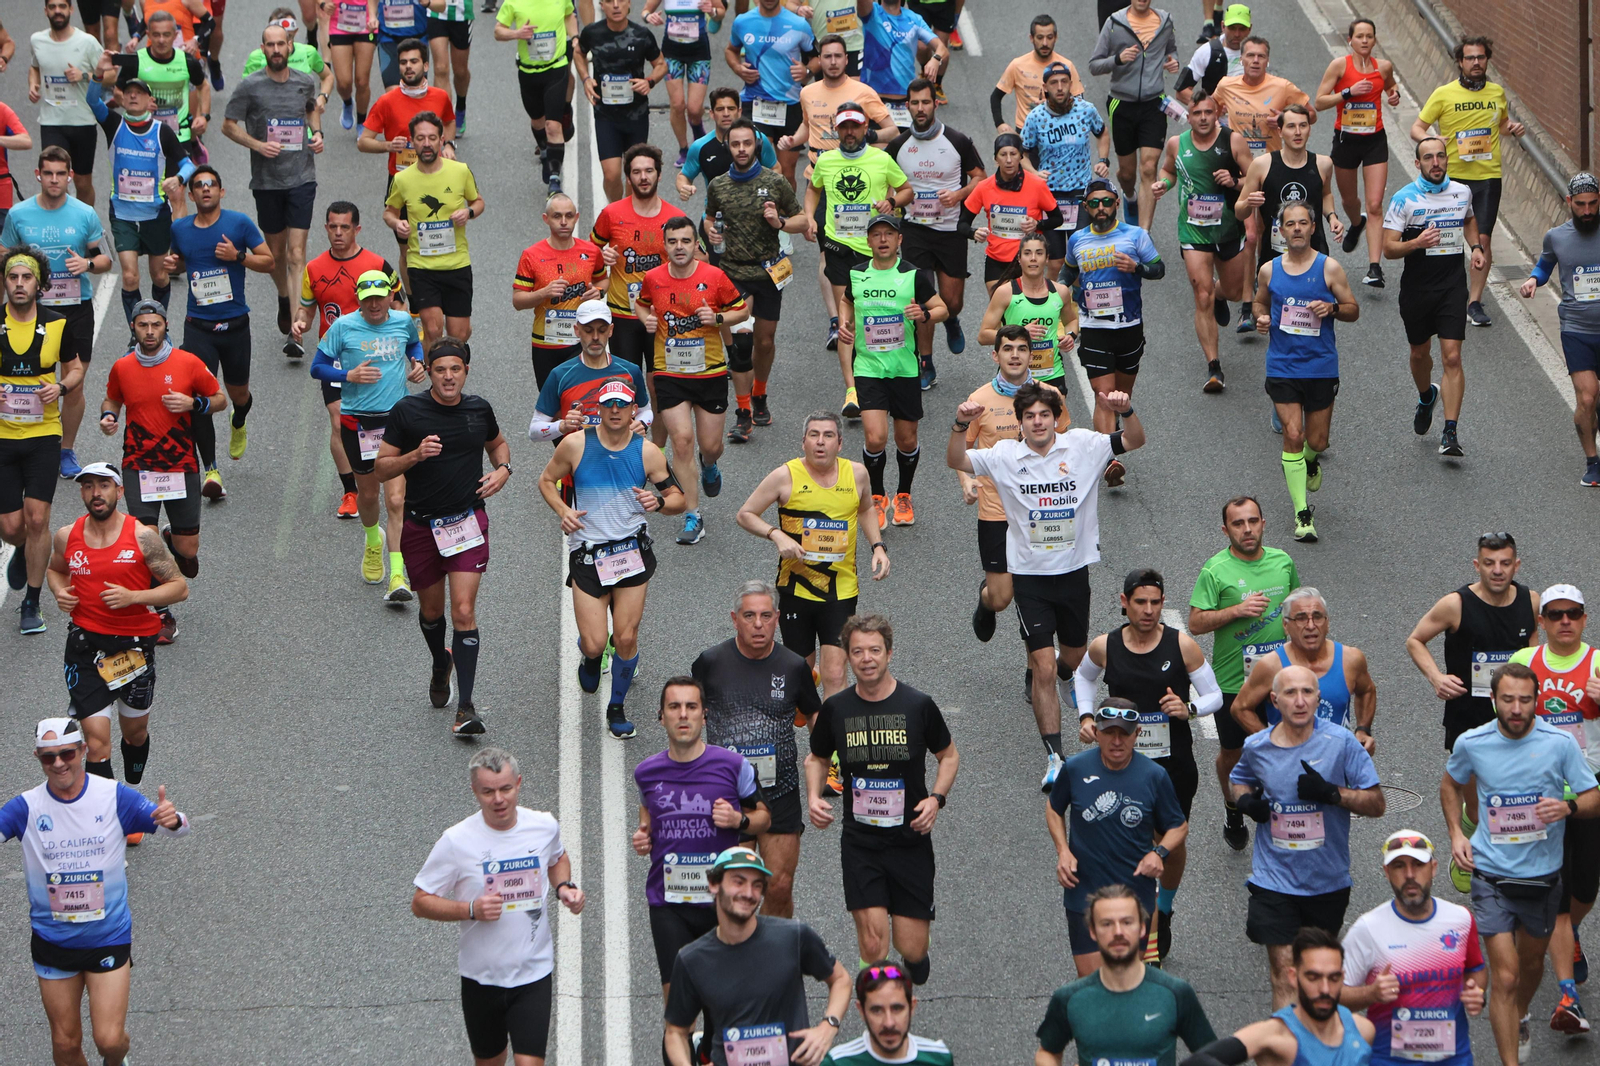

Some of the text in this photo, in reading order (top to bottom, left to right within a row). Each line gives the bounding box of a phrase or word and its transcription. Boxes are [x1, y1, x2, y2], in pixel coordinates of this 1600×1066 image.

[836, 8, 855, 17] ZURICH
[758, 35, 792, 44] ZURICH
[1047, 122, 1077, 145] COMO
[919, 160, 935, 169] edp
[130, 169, 151, 177] ZURICH
[428, 221, 449, 230] ZURICH
[1438, 220, 1460, 228] ZURICH
[1080, 244, 1115, 261] TEAM
[1095, 280, 1117, 288] ZURICH
[863, 289, 897, 299] sano
[876, 316, 899, 324] ZURICH
[606, 383, 623, 392] OTSO
[1020, 480, 1077, 495] SIEMENS
[1038, 495, 1079, 507] mobile
[1044, 510, 1070, 519] ZURICH
[819, 521, 845, 529] ZURICH
[770, 689, 785, 699] OTSO
[844, 713, 907, 731] RUN UTREG
[1547, 715, 1578, 724] ZURICH
[846, 729, 907, 748] RUN UTREG
[740, 747, 770, 756] ZURICH
[846, 746, 911, 763] RUN UTREG
[868, 780, 899, 789] ZURICH
[868, 796, 888, 805] 7435
[1504, 795, 1537, 805] ZURICH
[1285, 804, 1317, 813] ZURICH
[1505, 812, 1526, 822] 7495
[661, 817, 710, 832] MURCIA
[1286, 820, 1306, 828] 7494
[60, 835, 106, 849] CALIFATO
[41, 847, 106, 861] INDEPENDIENTE
[503, 859, 535, 871] ZURICH
[681, 855, 713, 865] ZURICH
[58, 860, 91, 871] SEVILLA
[64, 872, 97, 883] ZURICH
[681, 872, 701, 881] 9106
[503, 877, 524, 889] 8080
[64, 890, 85, 900] 7415
[1414, 1010, 1449, 1020] ZURICH
[743, 1026, 779, 1040] ZURICH
[1413, 1028, 1435, 1038] 7220
